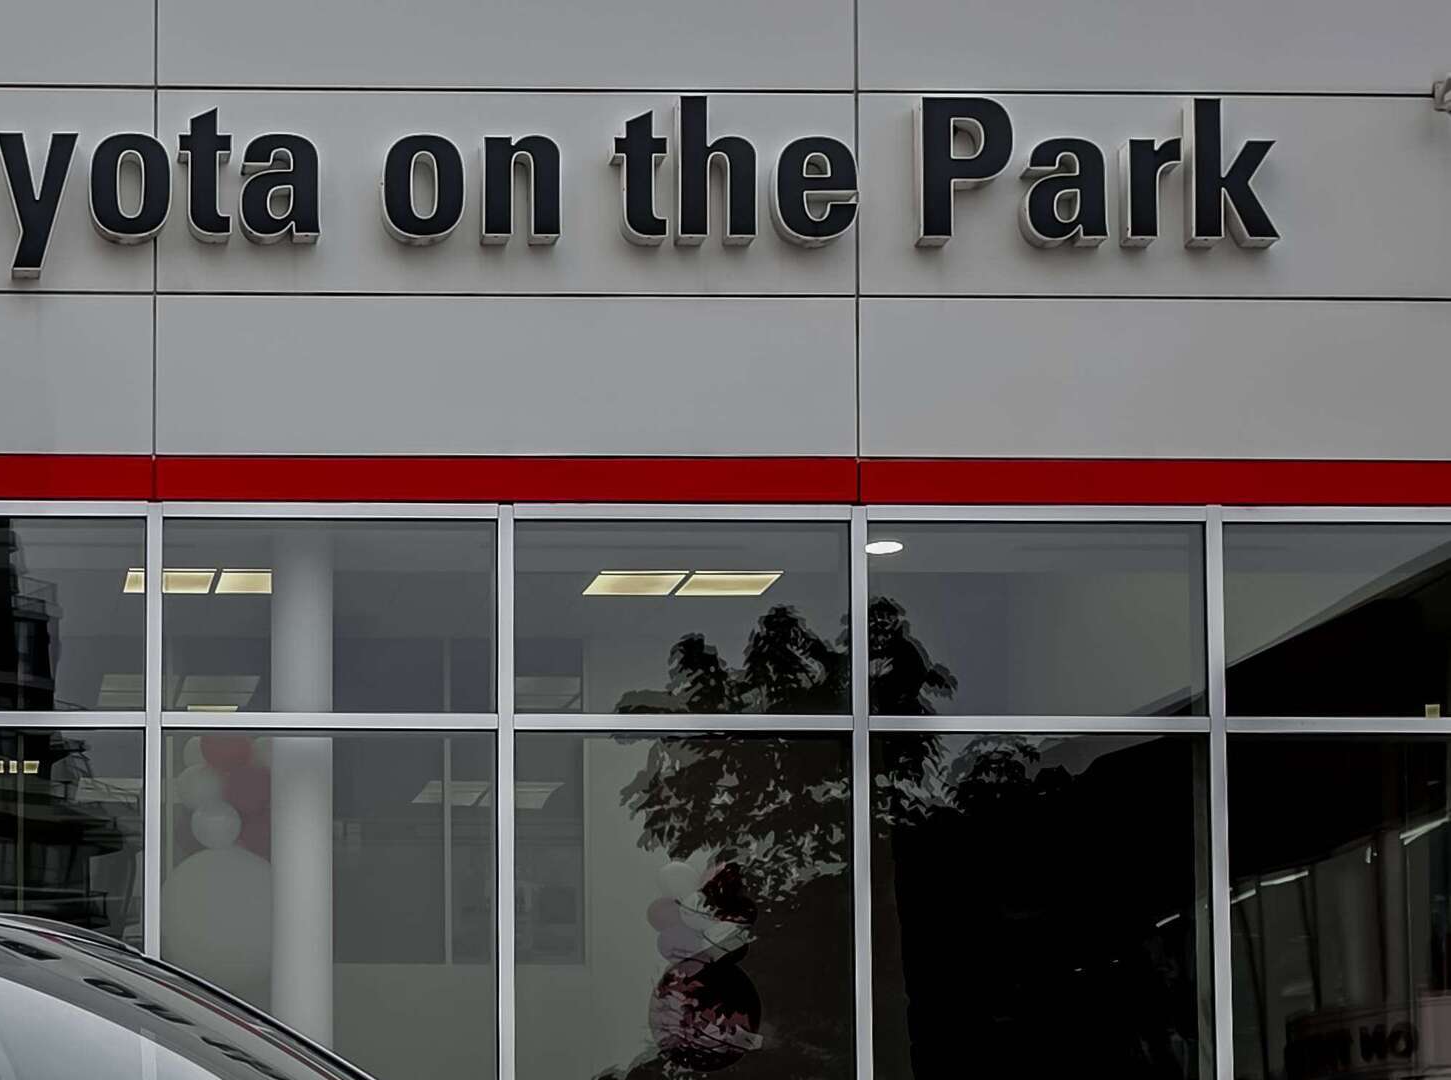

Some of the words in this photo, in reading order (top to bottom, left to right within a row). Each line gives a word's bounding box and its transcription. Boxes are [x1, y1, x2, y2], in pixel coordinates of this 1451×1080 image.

[381, 132, 560, 247] on
[612, 94, 860, 249] the
[916, 96, 1278, 249] Park
